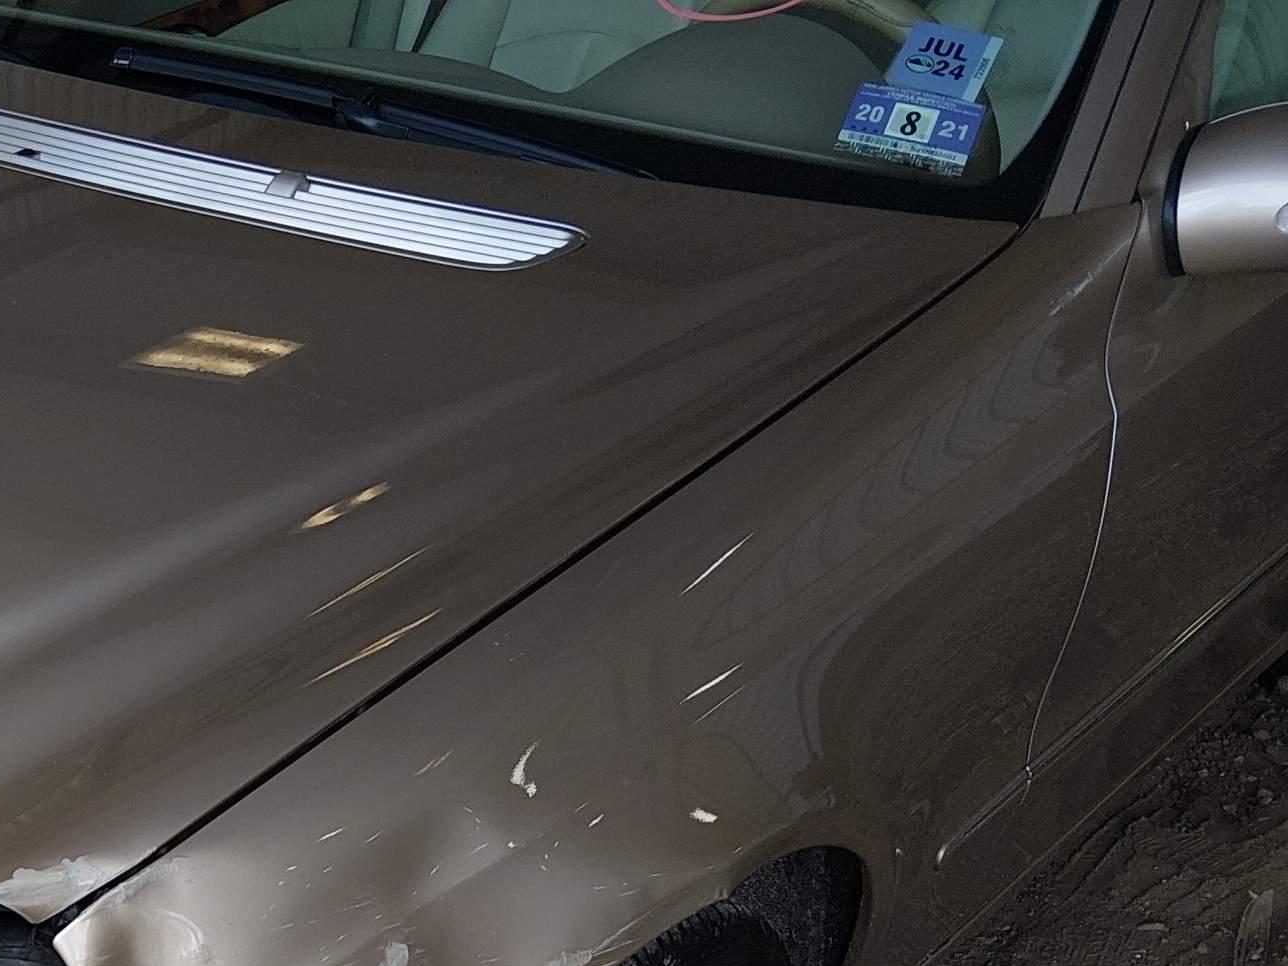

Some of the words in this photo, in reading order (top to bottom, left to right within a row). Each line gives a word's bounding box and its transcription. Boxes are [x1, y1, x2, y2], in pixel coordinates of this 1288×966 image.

[918, 37, 967, 62] JUL
[931, 60, 965, 81] 24
[855, 103, 885, 123] 20
[899, 111, 922, 136] 8
[938, 120, 969, 141] 21
